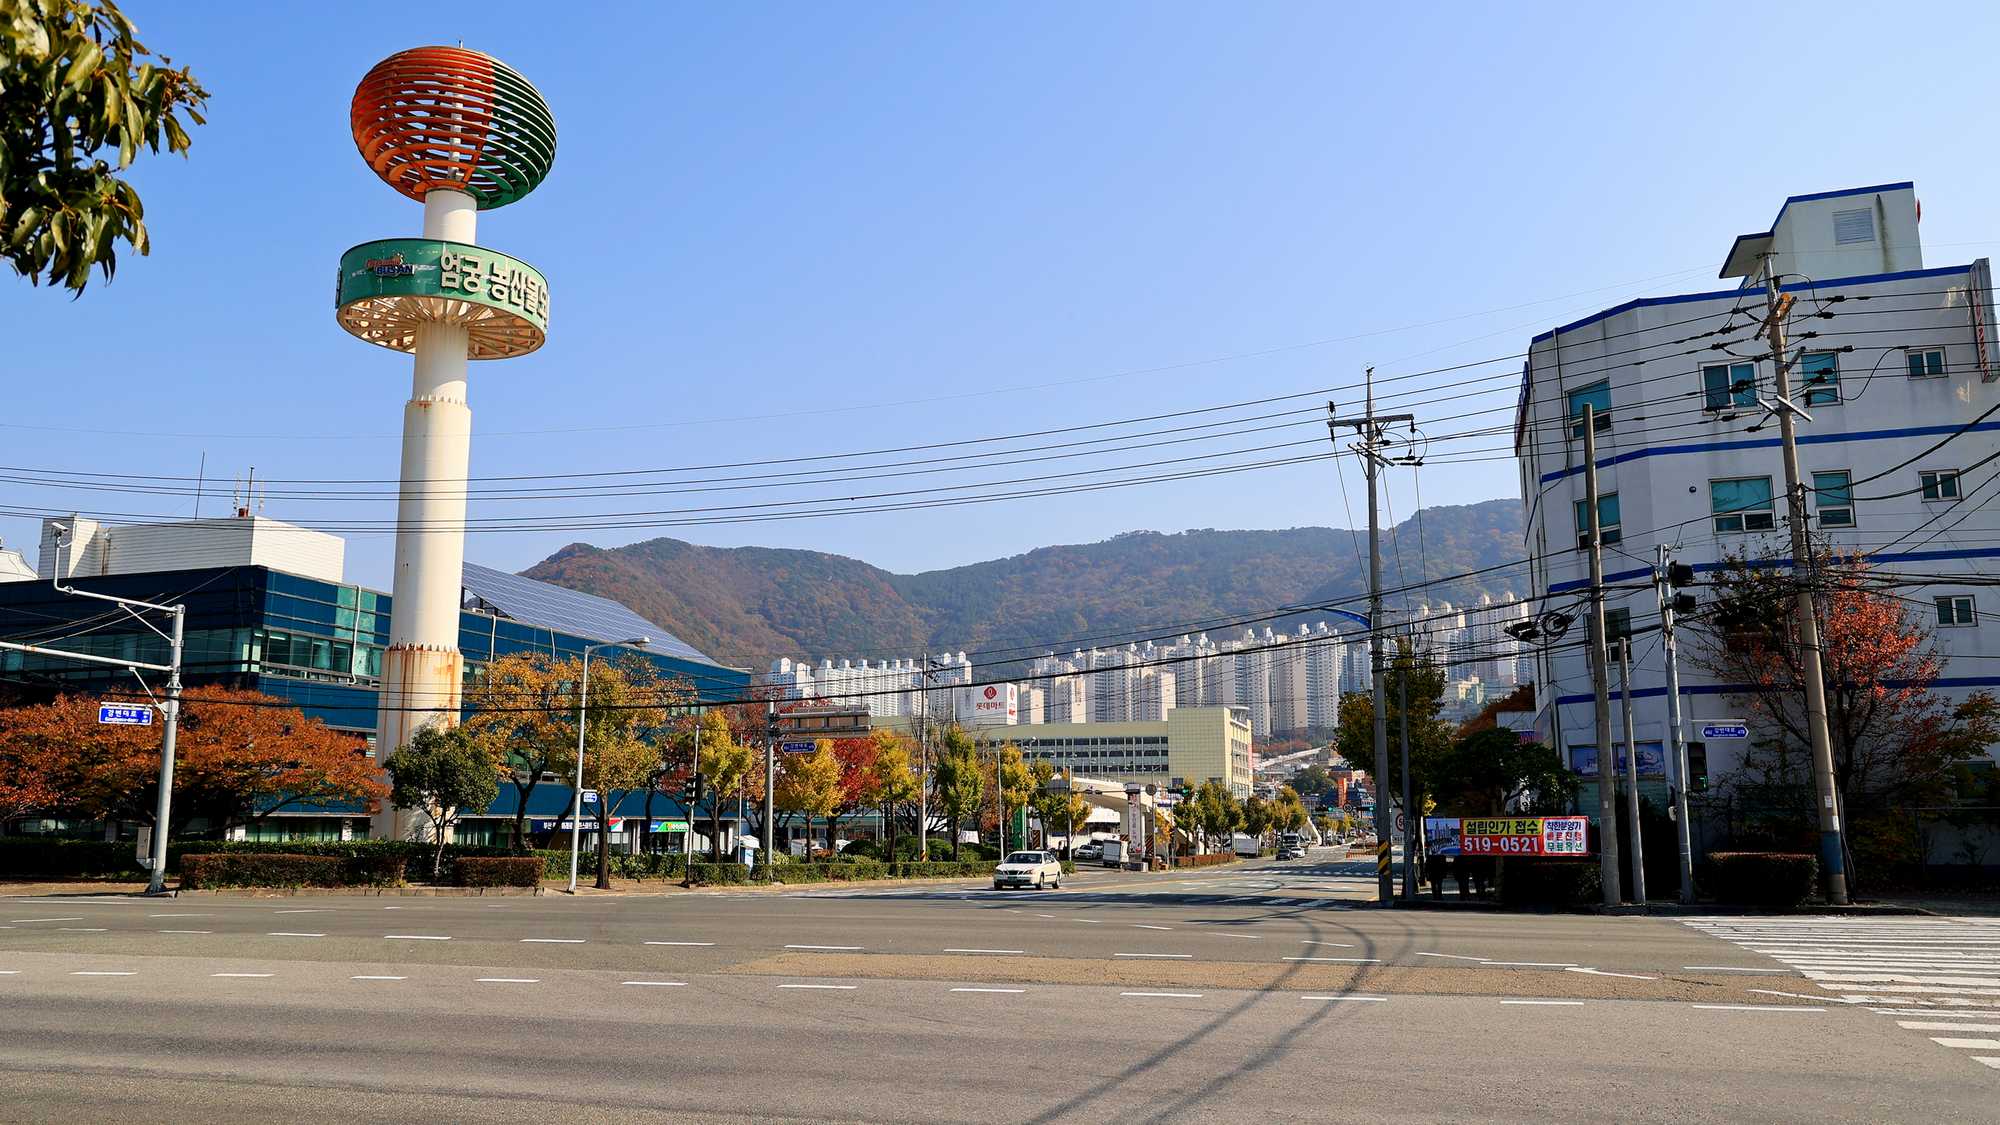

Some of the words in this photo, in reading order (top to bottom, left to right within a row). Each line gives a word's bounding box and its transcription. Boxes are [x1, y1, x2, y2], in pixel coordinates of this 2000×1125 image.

[376, 264, 415, 276] BUSAN
[440, 251, 481, 293] 엄궁
[1466, 820, 1510, 834] 설립인가
[1515, 820, 1538, 834] 접수
[1464, 838, 1539, 852] 519-0521
